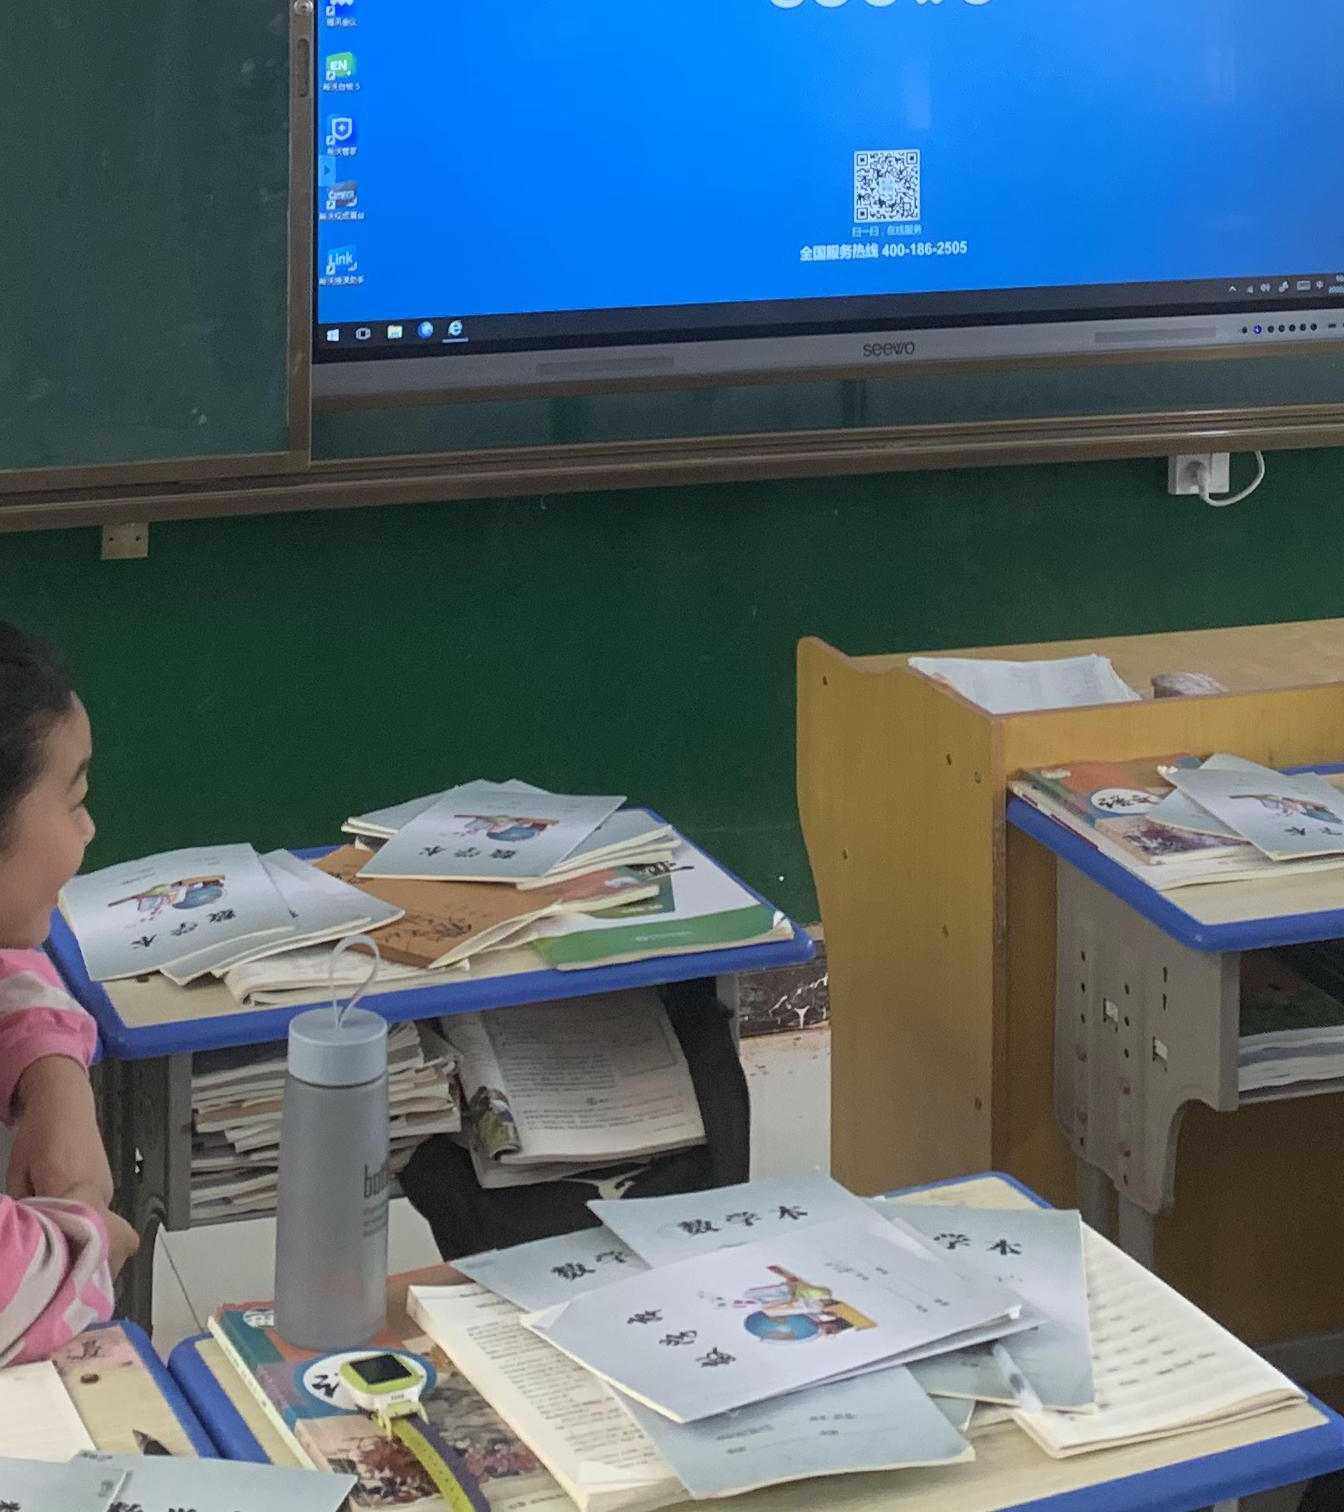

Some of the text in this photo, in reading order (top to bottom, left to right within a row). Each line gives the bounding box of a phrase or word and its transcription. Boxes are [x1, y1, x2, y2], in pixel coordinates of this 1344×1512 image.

[799, 240, 968, 262] 全国服务热线 400-186-2505
[862, 340, 916, 358] seewo
[676, 1204, 808, 1235] 数学本
